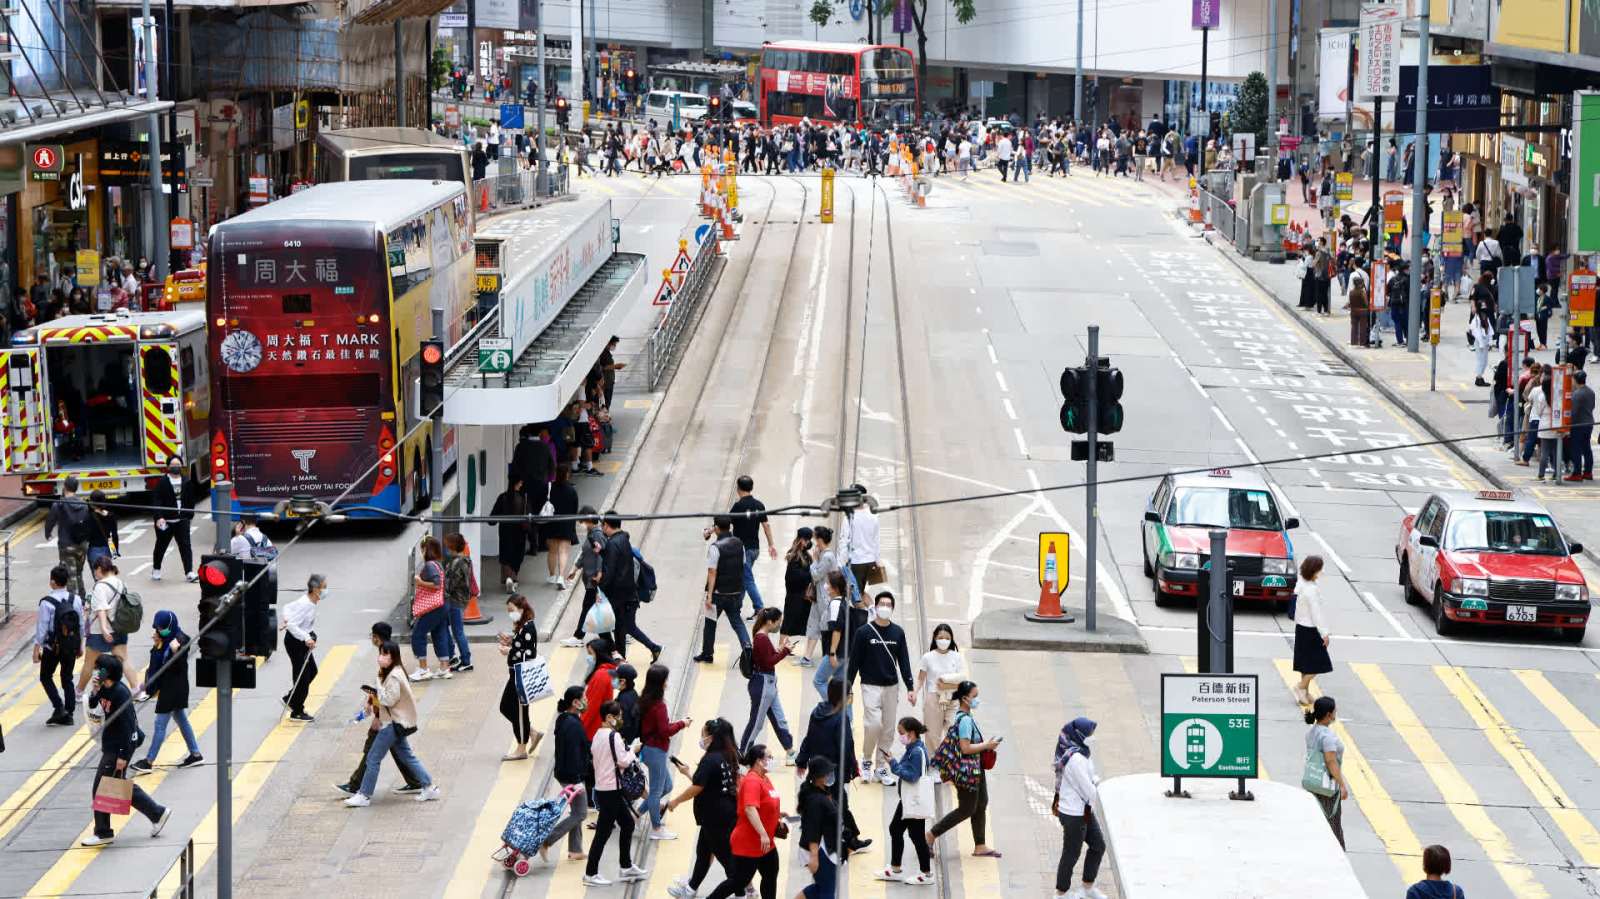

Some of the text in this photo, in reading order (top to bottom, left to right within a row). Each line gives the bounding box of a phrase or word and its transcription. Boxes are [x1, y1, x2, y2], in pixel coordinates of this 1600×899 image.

[1372, 25, 1382, 93] HONG KONG
[284, 240, 301, 248] 6410
[254, 258, 339, 284] 周大福
[267, 333, 380, 347] 周大福 T MARK
[267, 348, 381, 361] 天然鑽石最佳保證
[1291, 405, 1383, 426] 站
[1304, 427, 1423, 451] 巴士
[1313, 452, 1450, 470] STOP
[1347, 472, 1463, 489] BUS
[256, 484, 290, 493] Exclusively
[1508, 612, 1534, 621] 6703
[1199, 682, 1250, 694] 百德新街
[1228, 719, 1250, 728] 53E
